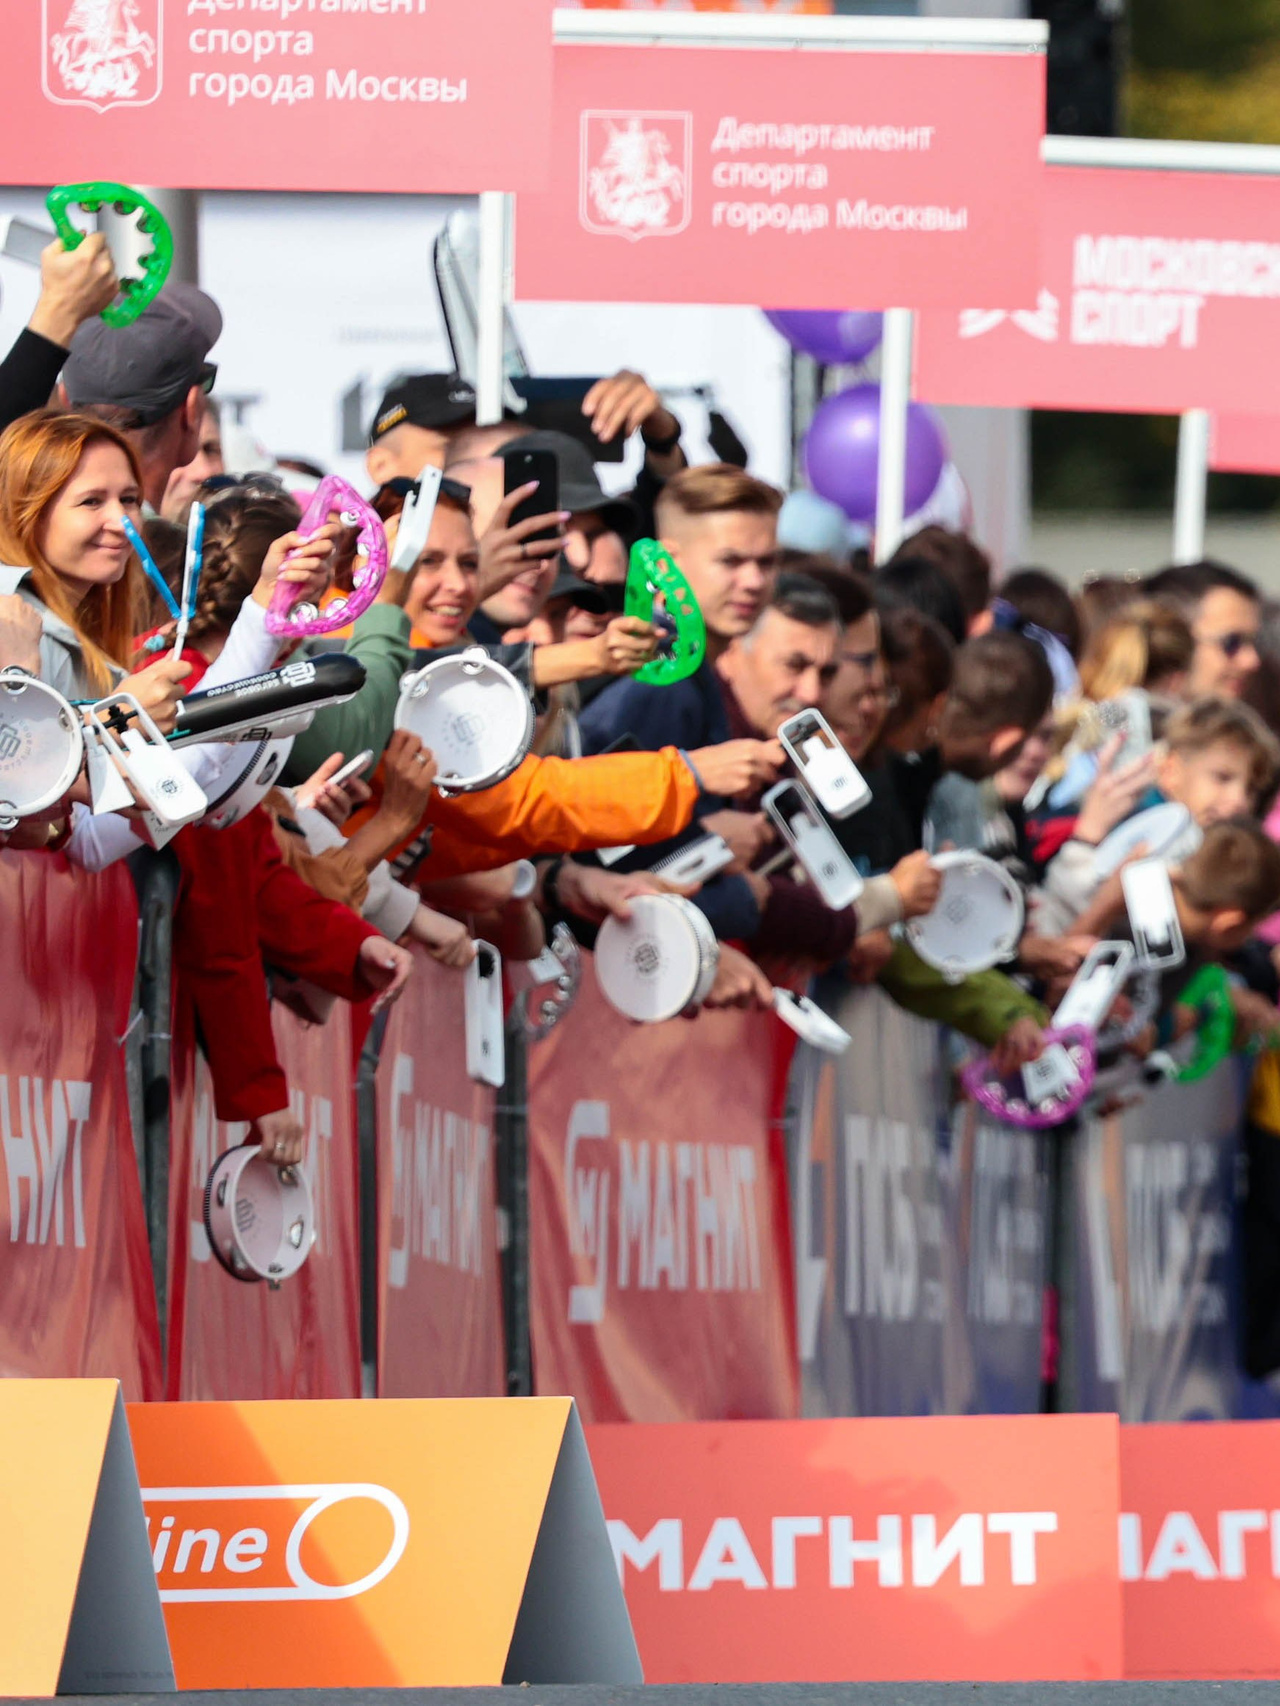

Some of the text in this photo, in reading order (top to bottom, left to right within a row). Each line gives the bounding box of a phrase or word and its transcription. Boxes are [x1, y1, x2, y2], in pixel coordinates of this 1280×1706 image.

[188, 28, 314, 63] спорта
[188, 68, 468, 106] города Москвы
[710, 116, 935, 156] Департамент
[712, 161, 828, 195] спорта
[712, 198, 968, 234] города Москвы
[1071, 289, 1206, 349] СПОРТ
[618, 1137, 761, 1293] МАГНИТ
[606, 1511, 1058, 1591] МАГНИТ
